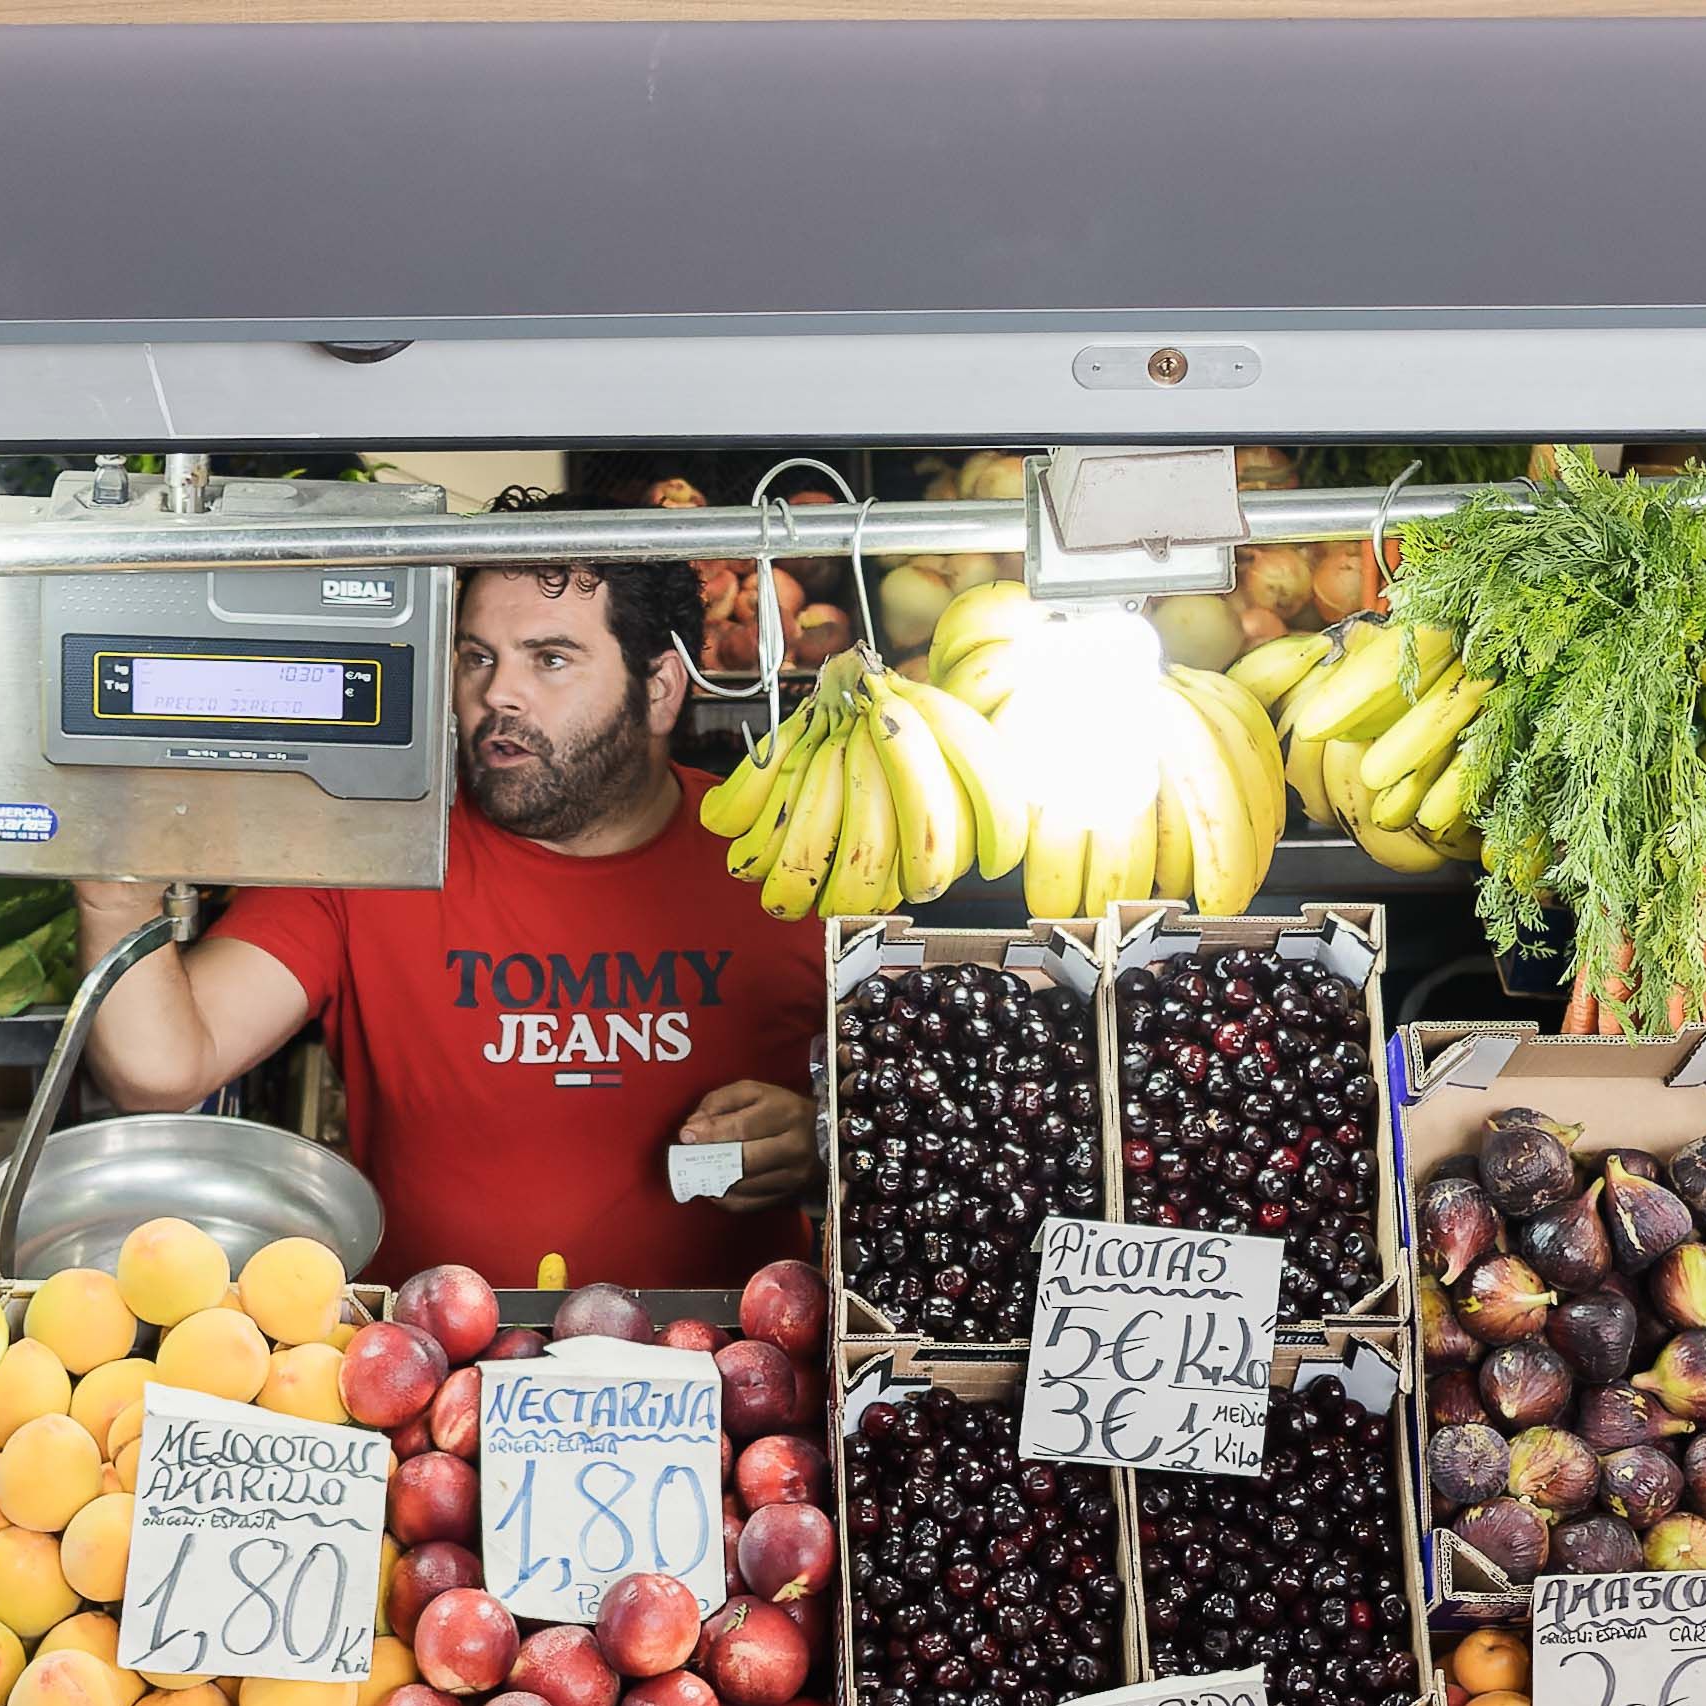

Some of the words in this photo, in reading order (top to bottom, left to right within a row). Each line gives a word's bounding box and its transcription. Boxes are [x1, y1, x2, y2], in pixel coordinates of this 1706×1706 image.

[321, 579, 394, 599] DIBAL
[446, 949, 734, 1010] TOMMY
[482, 1011, 692, 1065] JEANS
[151, 1420, 381, 1474] MELOCOTON
[1033, 1380, 1165, 1463] 3€
[494, 1460, 709, 1599] 1,80
[130, 1532, 348, 1673] 1,80
